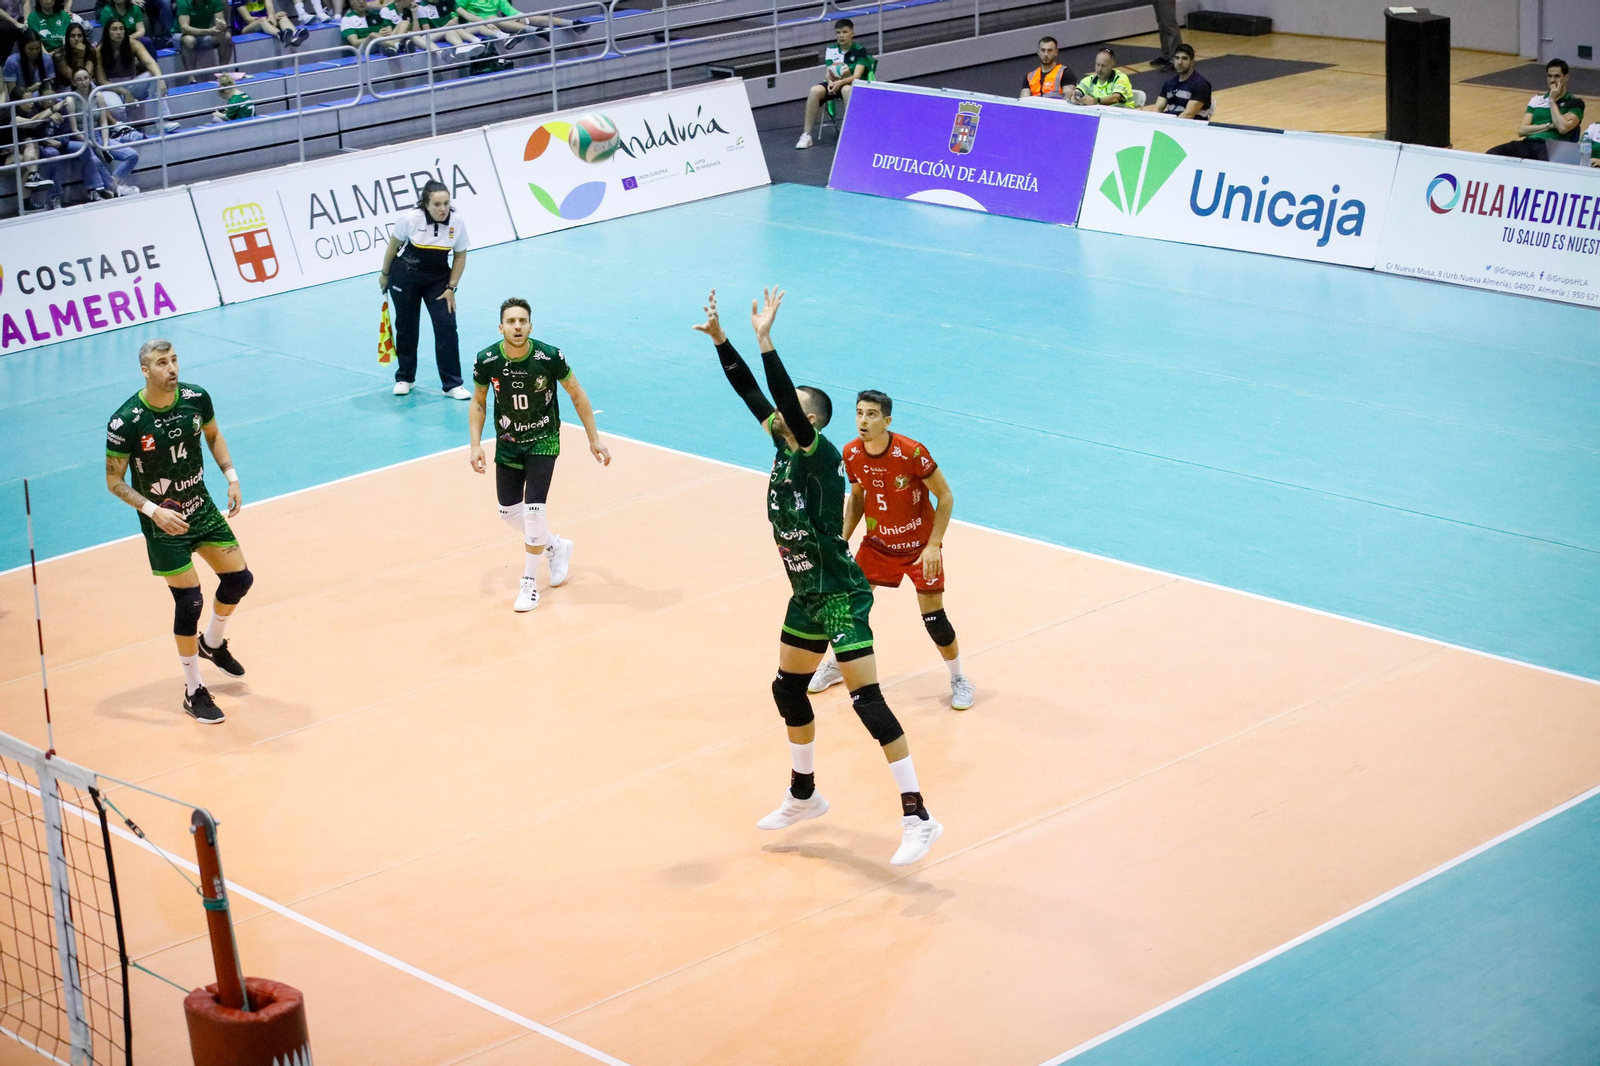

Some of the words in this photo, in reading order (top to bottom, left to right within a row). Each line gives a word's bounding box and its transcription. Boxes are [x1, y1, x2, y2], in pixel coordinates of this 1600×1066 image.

[872, 153, 956, 180] DIPUTACIÓN
[957, 165, 975, 182] DE
[975, 169, 1038, 192] ALMERÍA
[1190, 168, 1366, 247] Unicaja
[1461, 180, 1506, 218] HLA
[315, 222, 396, 260] CIUDA
[1502, 226, 1514, 244] TU
[1516, 229, 1551, 249] SALUD
[1552, 233, 1566, 250] ES
[17, 254, 118, 295] COSTA
[121, 245, 161, 274] DE
[1493, 266, 1536, 280] @GrupoHLA
[1546, 273, 1589, 287] @GrupoHLA
[1385, 262, 1394, 271] C/
[1394, 264, 1416, 276] Nueva
[1537, 285, 1565, 296] Almería
[1571, 290, 1585, 299] 950
[1586, 293, 1599, 302] 621
[1, 275, 177, 349] ALMERÍA
[511, 394, 529, 410] 10
[514, 415, 550, 432] Unicaja
[169, 441, 188, 464] 14
[876, 494, 888, 511] 5
[879, 516, 922, 536] Unicaja
[911, 541, 921, 549] DE
